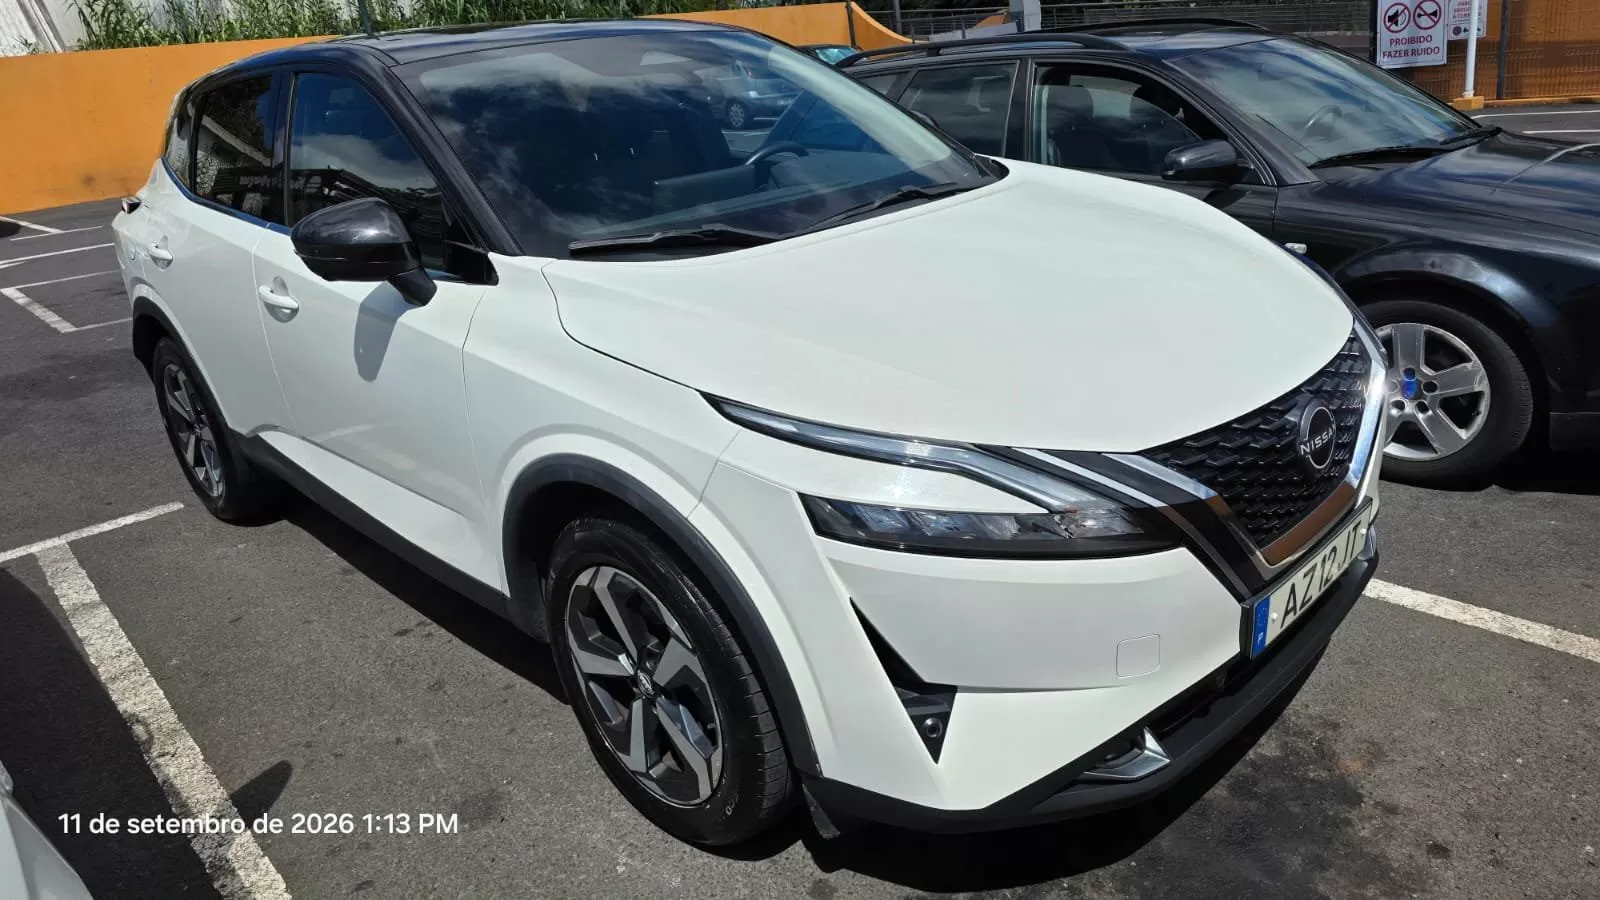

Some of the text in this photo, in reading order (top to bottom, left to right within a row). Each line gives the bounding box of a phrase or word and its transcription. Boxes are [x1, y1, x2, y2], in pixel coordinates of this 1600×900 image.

[1389, 35, 1433, 47] PROIBIDO
[1382, 46, 1440, 59] FAZER RUIDO
[1280, 562, 1318, 629] AZ
[1318, 545, 1338, 593] 12
